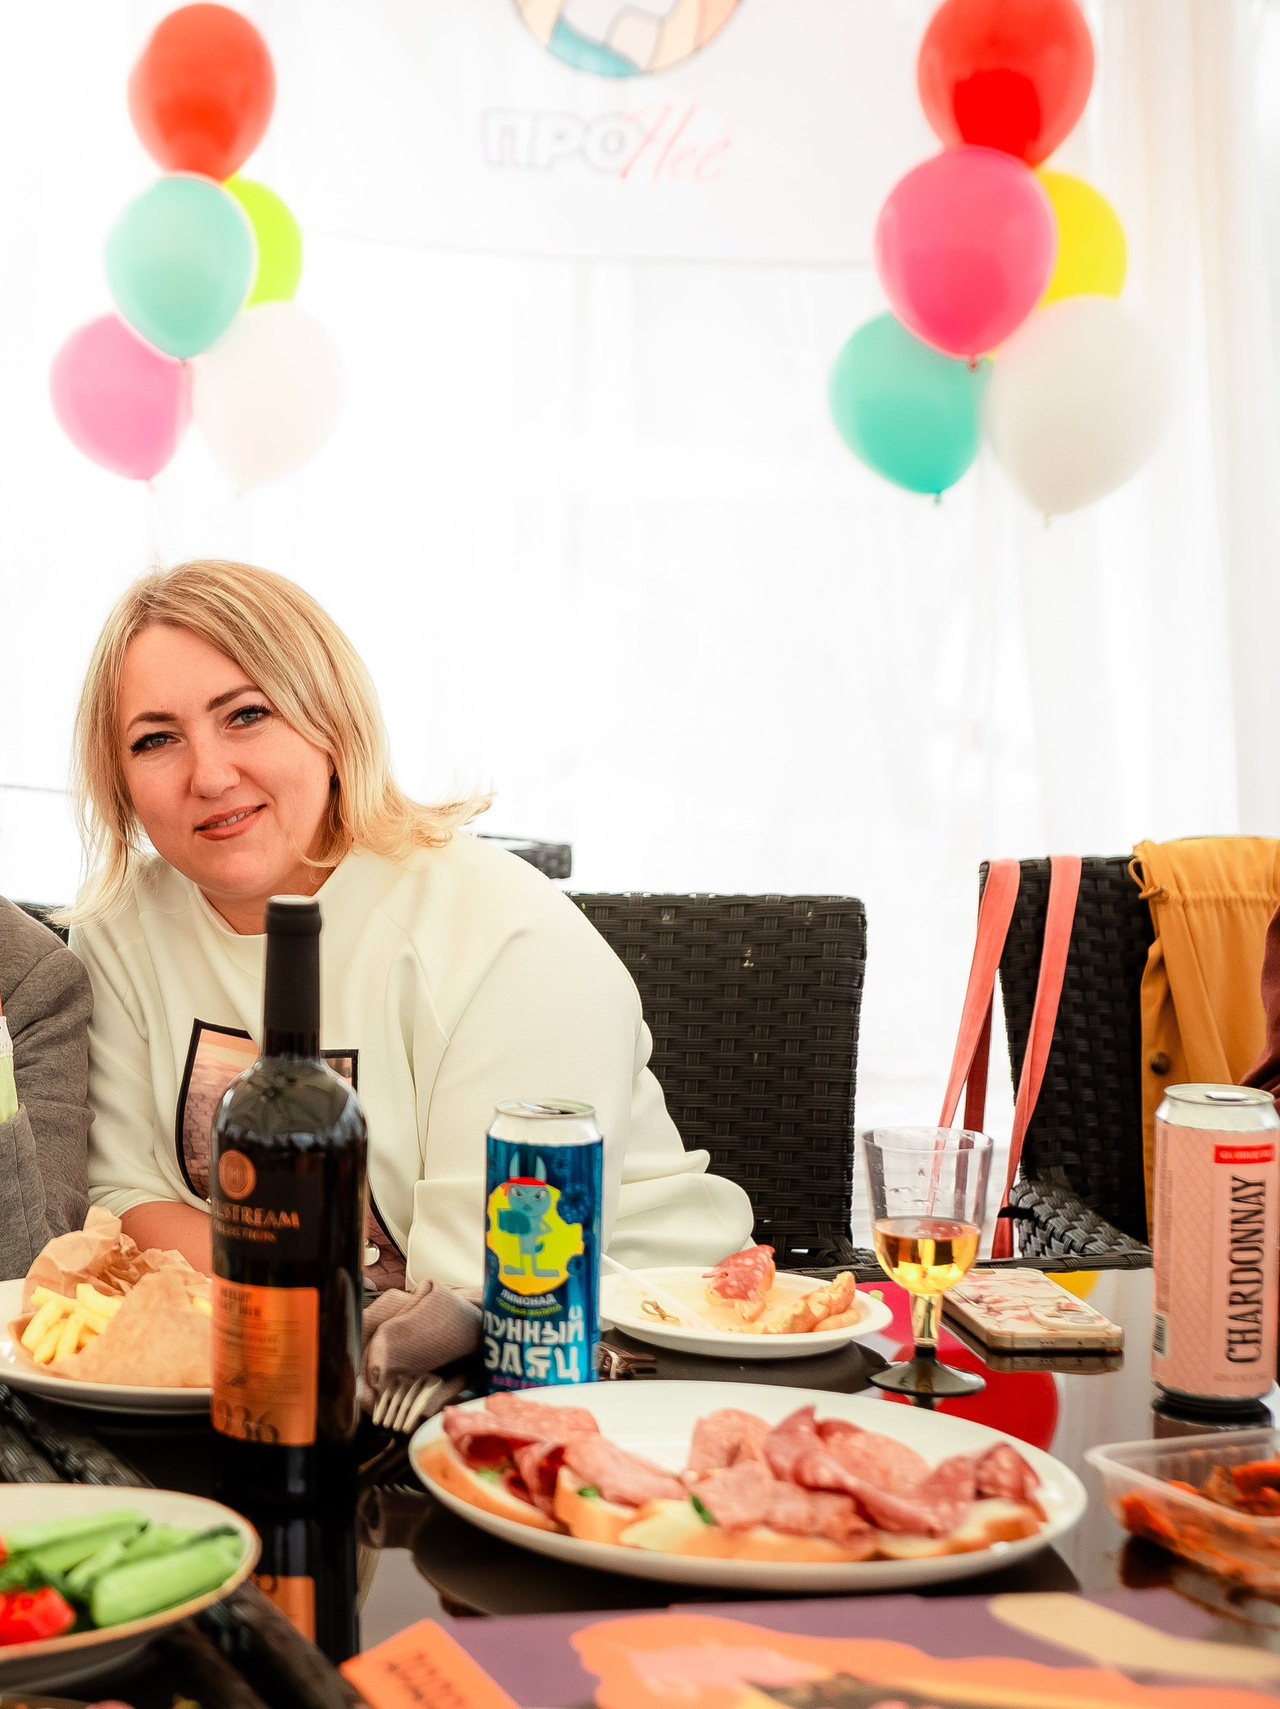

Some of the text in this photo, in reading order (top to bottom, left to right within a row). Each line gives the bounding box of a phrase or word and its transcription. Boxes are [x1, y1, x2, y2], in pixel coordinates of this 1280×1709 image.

[1227, 1175, 1266, 1363] CHARDONNAY
[501, 1289, 558, 1308] ЛИМОНАД
[483, 1305, 585, 1345] ЛУННЫЙ
[484, 1336, 580, 1383] ЗАЯЦ
